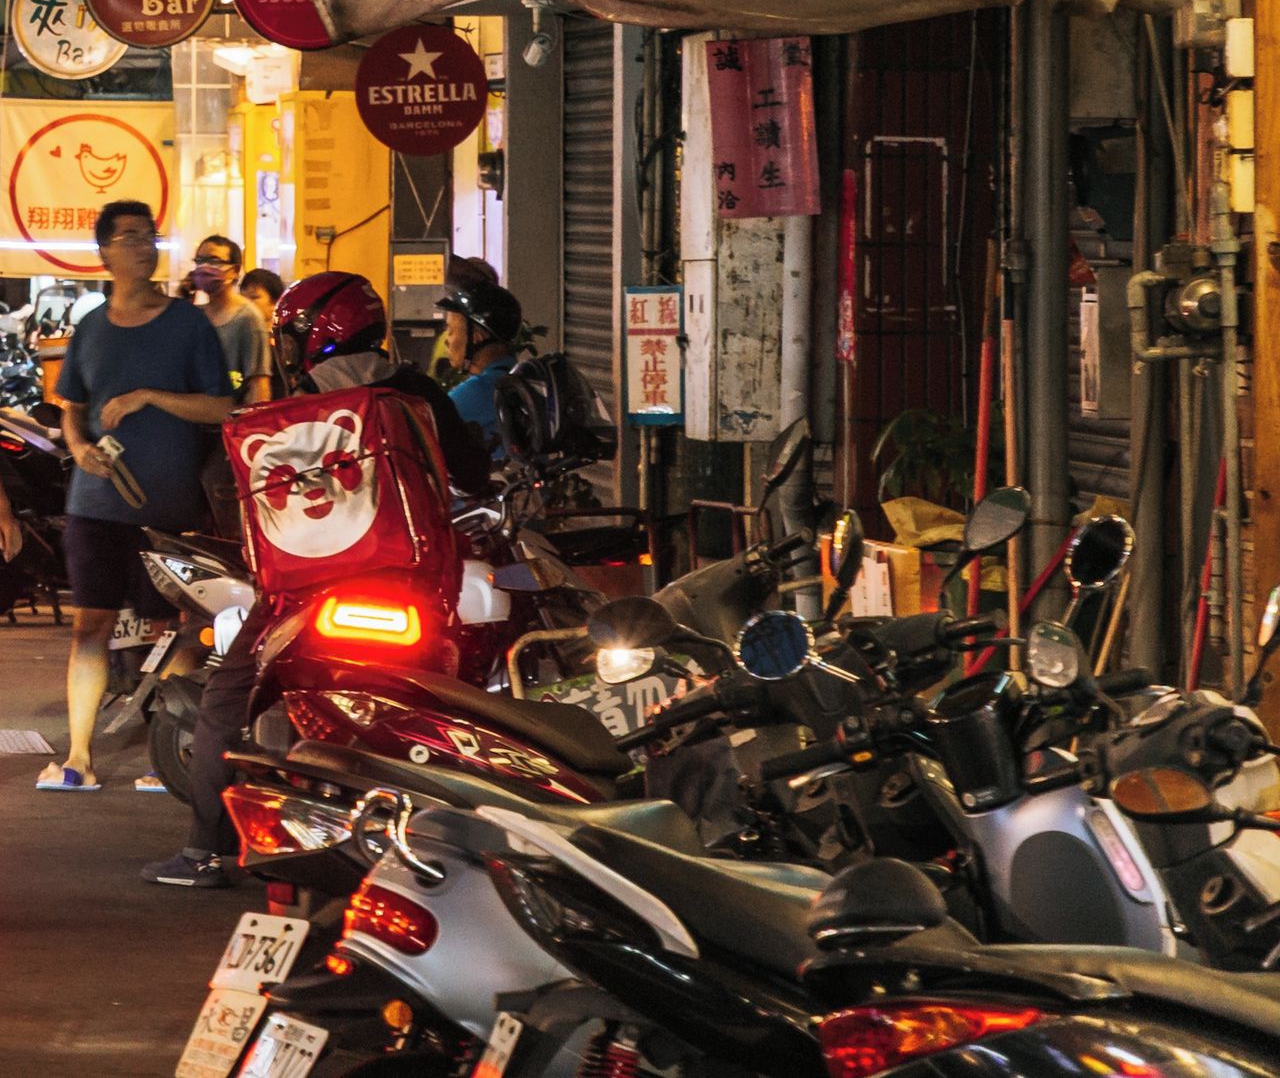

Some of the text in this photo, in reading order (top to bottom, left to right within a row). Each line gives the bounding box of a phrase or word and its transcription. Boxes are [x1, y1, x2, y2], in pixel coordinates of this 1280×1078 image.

[368, 82, 478, 105] ESTRELLA
[403, 104, 444, 115] DAMM
[389, 120, 463, 130] BARCELONA
[751, 87, 787, 190] 工讀生
[630, 295, 678, 324] 紅線
[639, 337, 669, 405] 禁止停車
